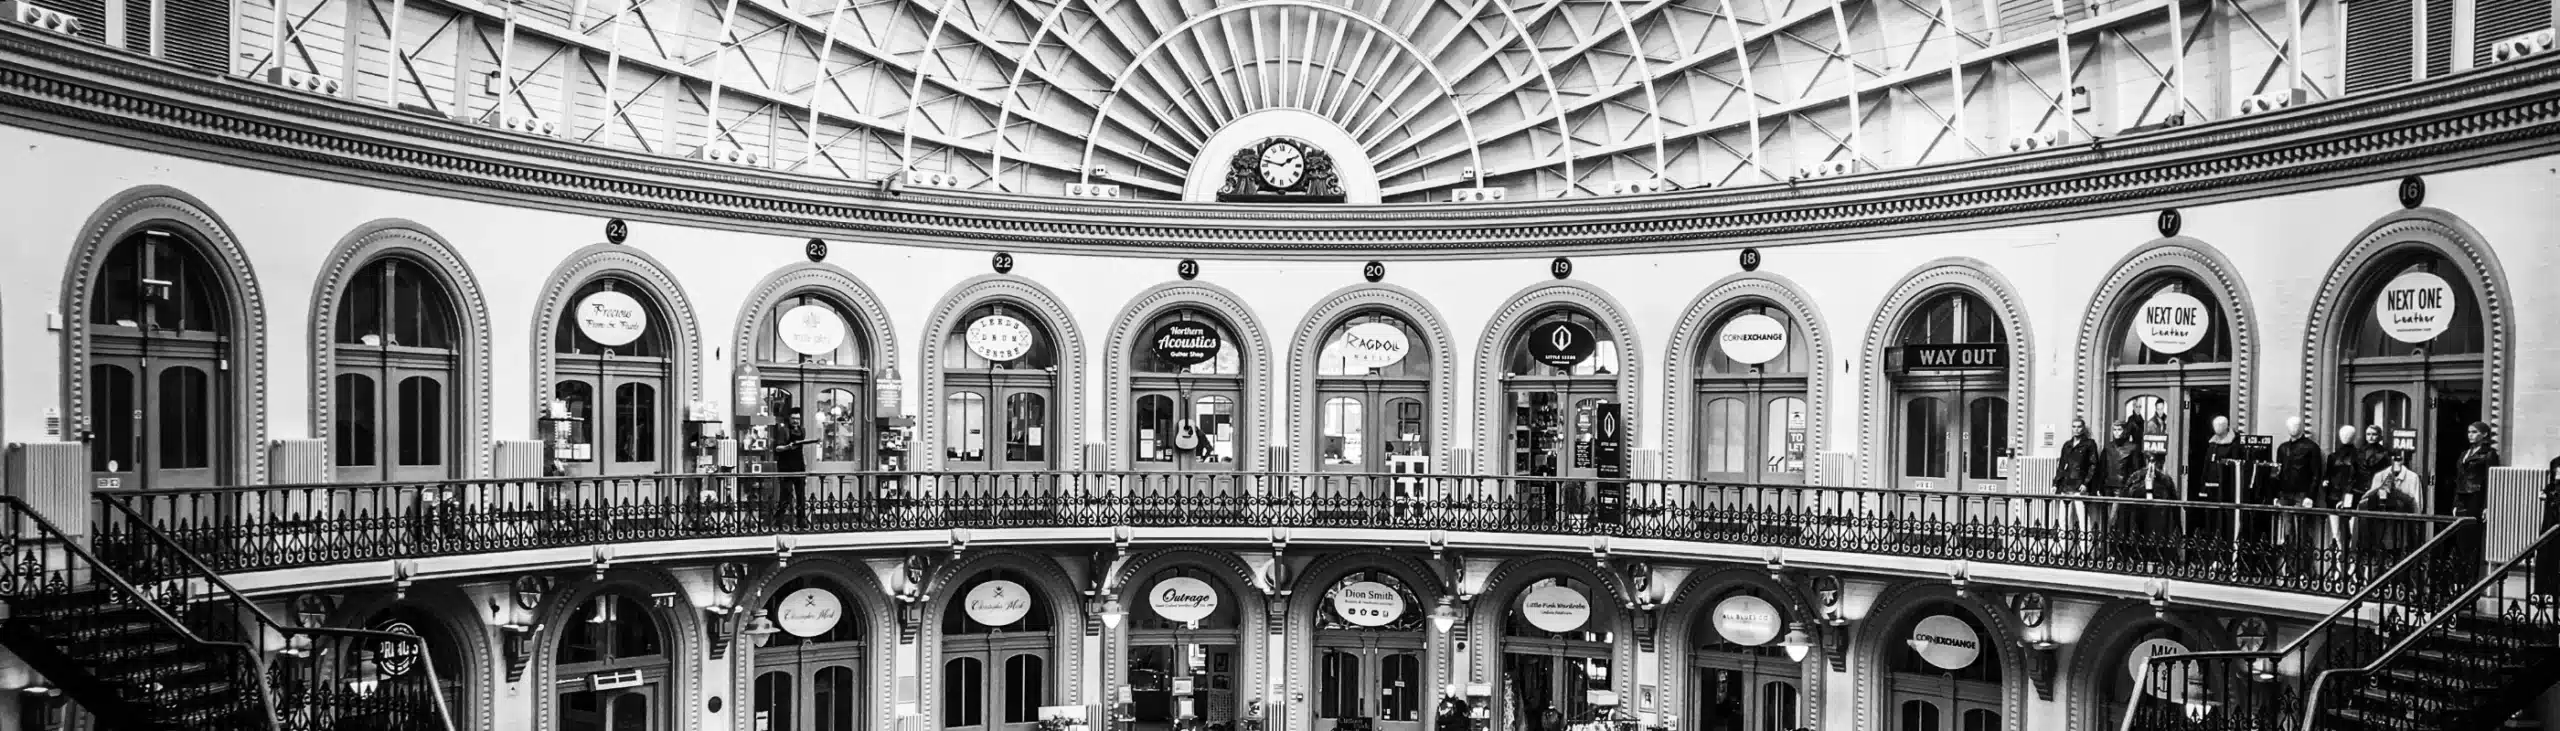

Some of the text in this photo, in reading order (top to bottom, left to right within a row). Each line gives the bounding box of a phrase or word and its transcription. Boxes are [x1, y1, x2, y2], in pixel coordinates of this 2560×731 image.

[2402, 183, 2418, 200] 16
[2161, 214, 2175, 230] 17
[610, 223, 626, 237] 24
[809, 243, 826, 256] 23
[995, 256, 1011, 268] 22
[1743, 252, 1756, 265] 18
[1181, 262, 1195, 275] 21
[1366, 265, 1383, 277] 20
[1554, 261, 1569, 273] 19
[2387, 287, 2443, 311] NEXT ONE
[2147, 306, 2197, 326] NEXT ONE
[2393, 313, 2435, 325] Leather
[980, 318, 1020, 330] LEEDS
[1170, 326, 1204, 336] Northern
[2151, 327, 2189, 337] Leather
[982, 333, 1017, 342] DRUM
[1158, 334, 1217, 350] Acoustics
[1346, 332, 1400, 352] RAGDOLL
[978, 346, 1020, 358] CENTRE
[1919, 348, 1997, 366] WAY OUT
[1790, 433, 1804, 442] TO
[1788, 442, 1805, 452] LET
[2143, 441, 2167, 452] RAIL
[2393, 438, 2416, 450] RAIL
[1162, 587, 1210, 608] Outrage
[1345, 588, 1394, 601] Dion Smith
[1526, 601, 1542, 609] Little
